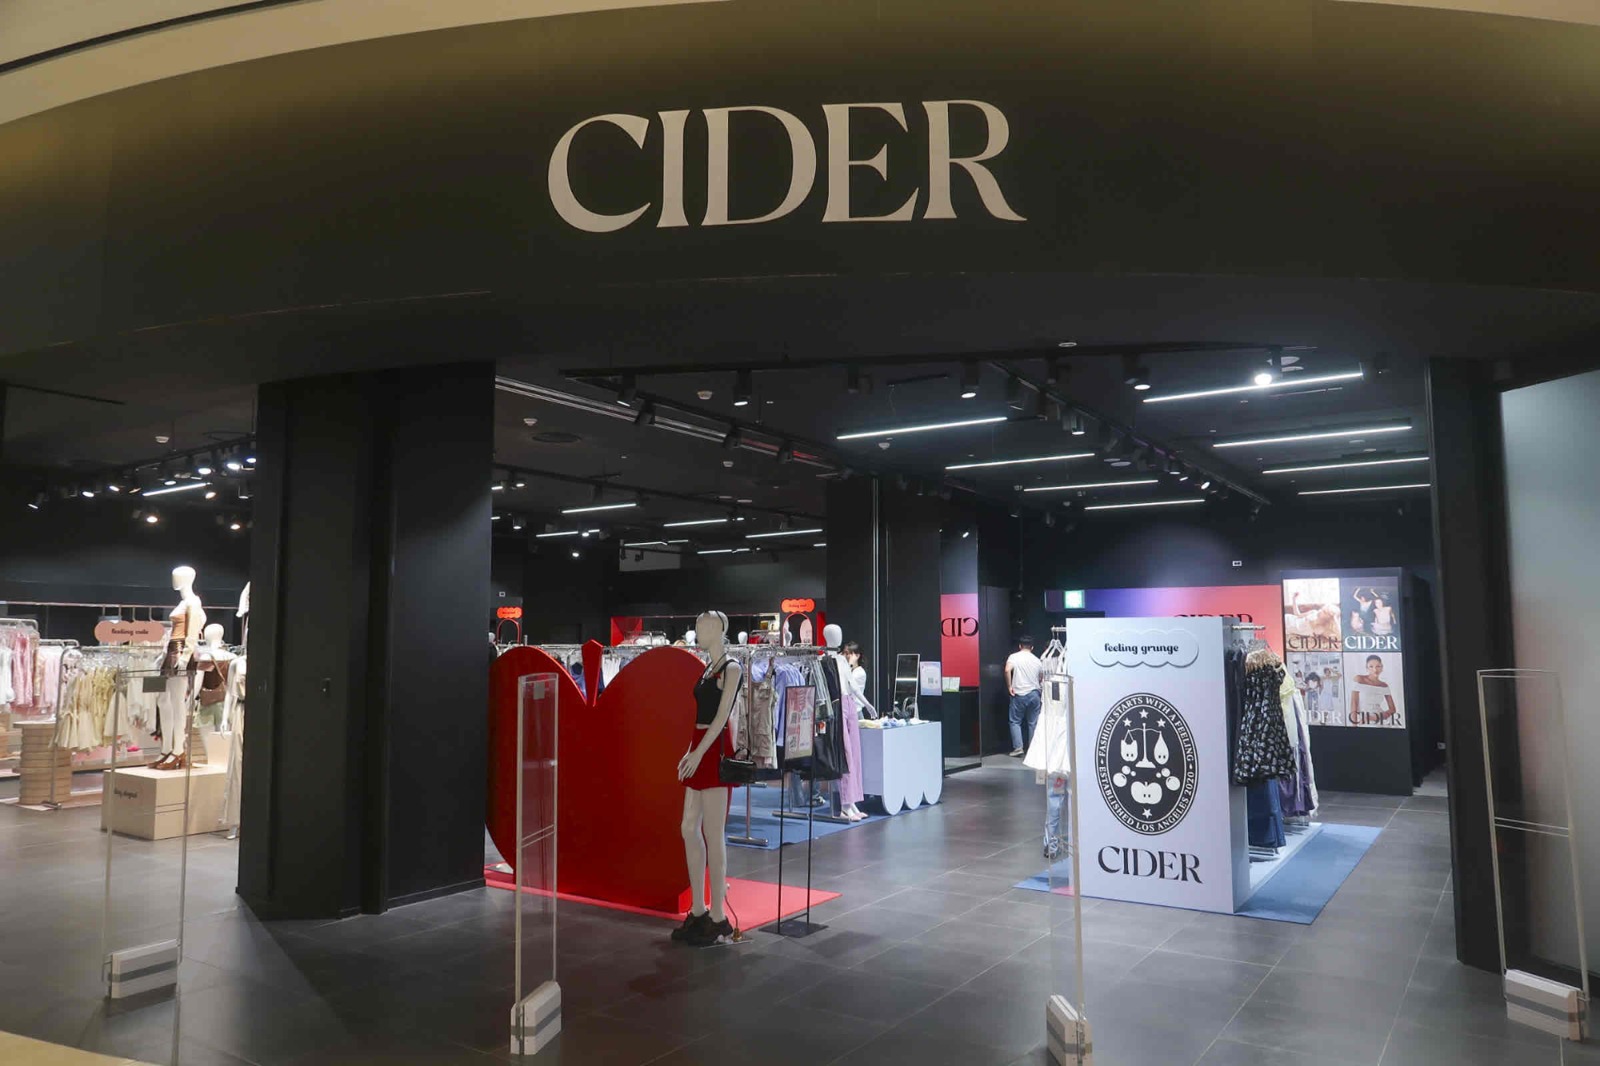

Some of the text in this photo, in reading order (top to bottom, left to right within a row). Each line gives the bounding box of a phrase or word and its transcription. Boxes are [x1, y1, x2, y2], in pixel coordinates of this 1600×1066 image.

[548, 99, 1027, 232] CIDER
[1104, 643, 1179, 655] feeling grunge
[1287, 635, 1340, 650] CIDER
[1344, 635, 1398, 650] CIDER
[1304, 709, 1343, 724] IDER
[1348, 711, 1402, 726] CIDER
[1098, 697, 1194, 762] FASHION STARTS WITH A FEELING
[1098, 766, 1195, 832] ESTABLISHED LOS ANGELES 2020
[1098, 845, 1204, 884] CIDER
